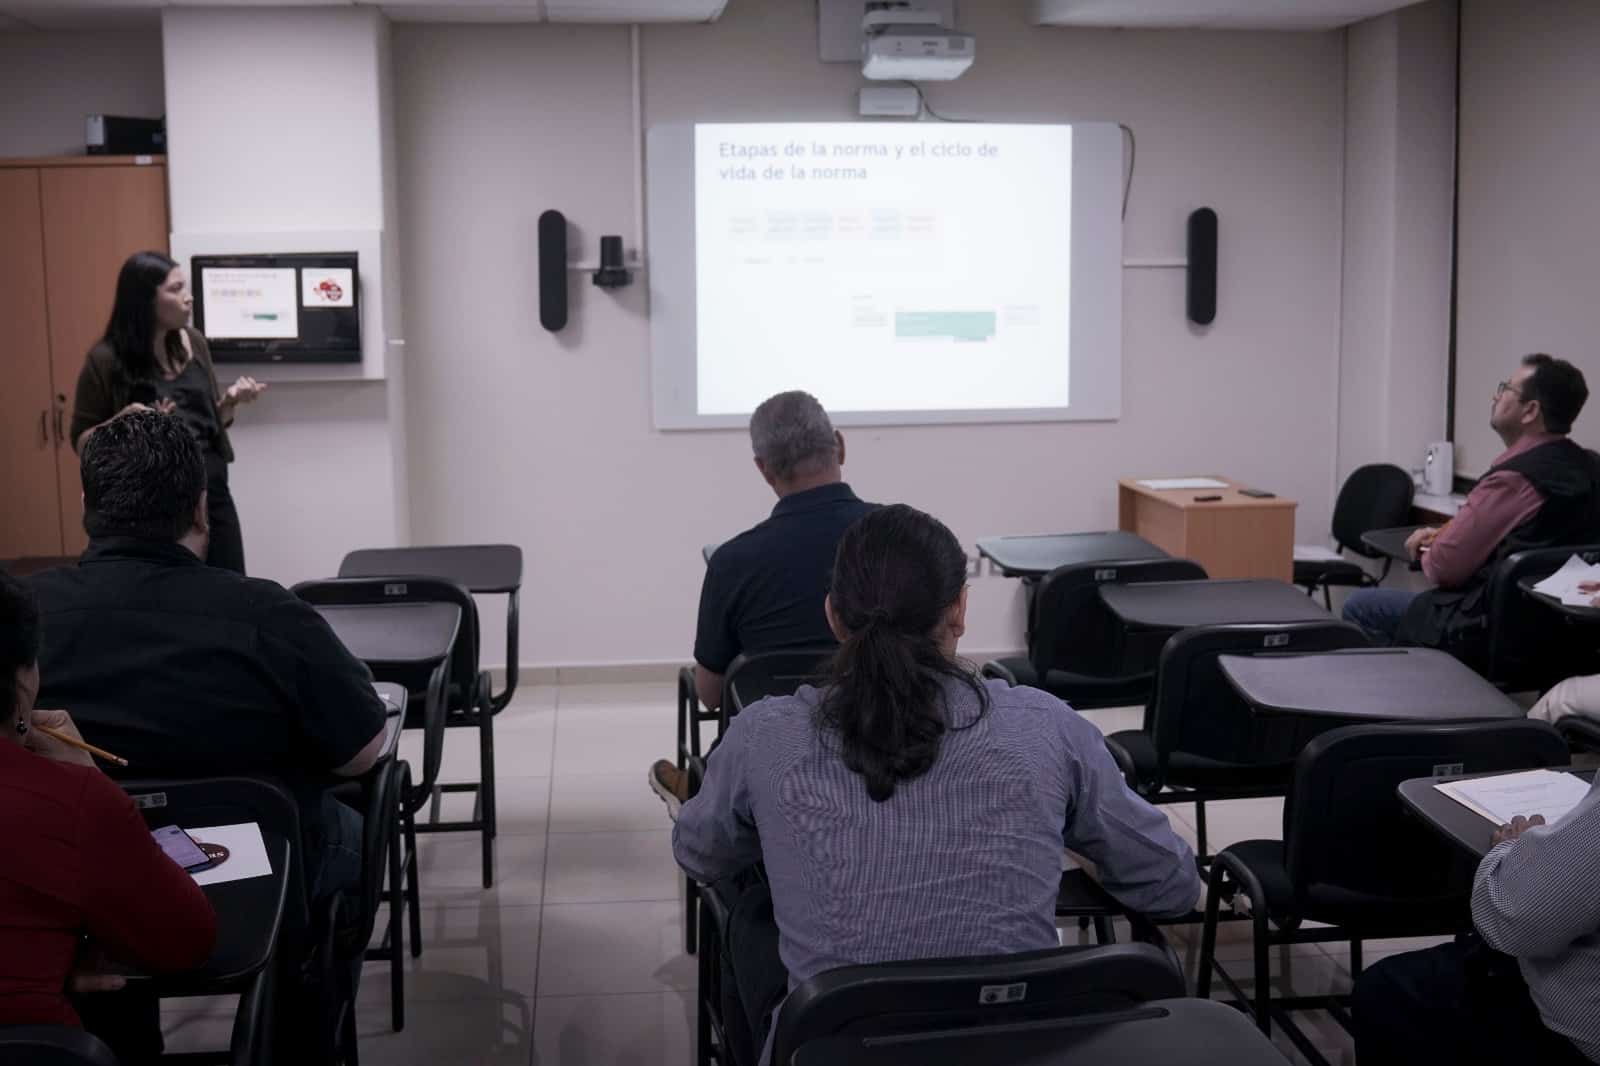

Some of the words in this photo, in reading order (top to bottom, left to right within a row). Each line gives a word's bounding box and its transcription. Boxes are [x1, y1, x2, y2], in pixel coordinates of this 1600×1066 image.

[719, 142, 778, 160] Etapas
[783, 140, 805, 157] de
[812, 140, 827, 157] la
[832, 144, 888, 157] norma
[894, 144, 904, 161] y
[909, 140, 926, 157] el
[931, 140, 972, 157] ciclo
[977, 140, 999, 157] de
[719, 163, 757, 180] vida
[761, 163, 785, 180] de
[791, 163, 806, 180] la
[812, 167, 868, 180] norma
